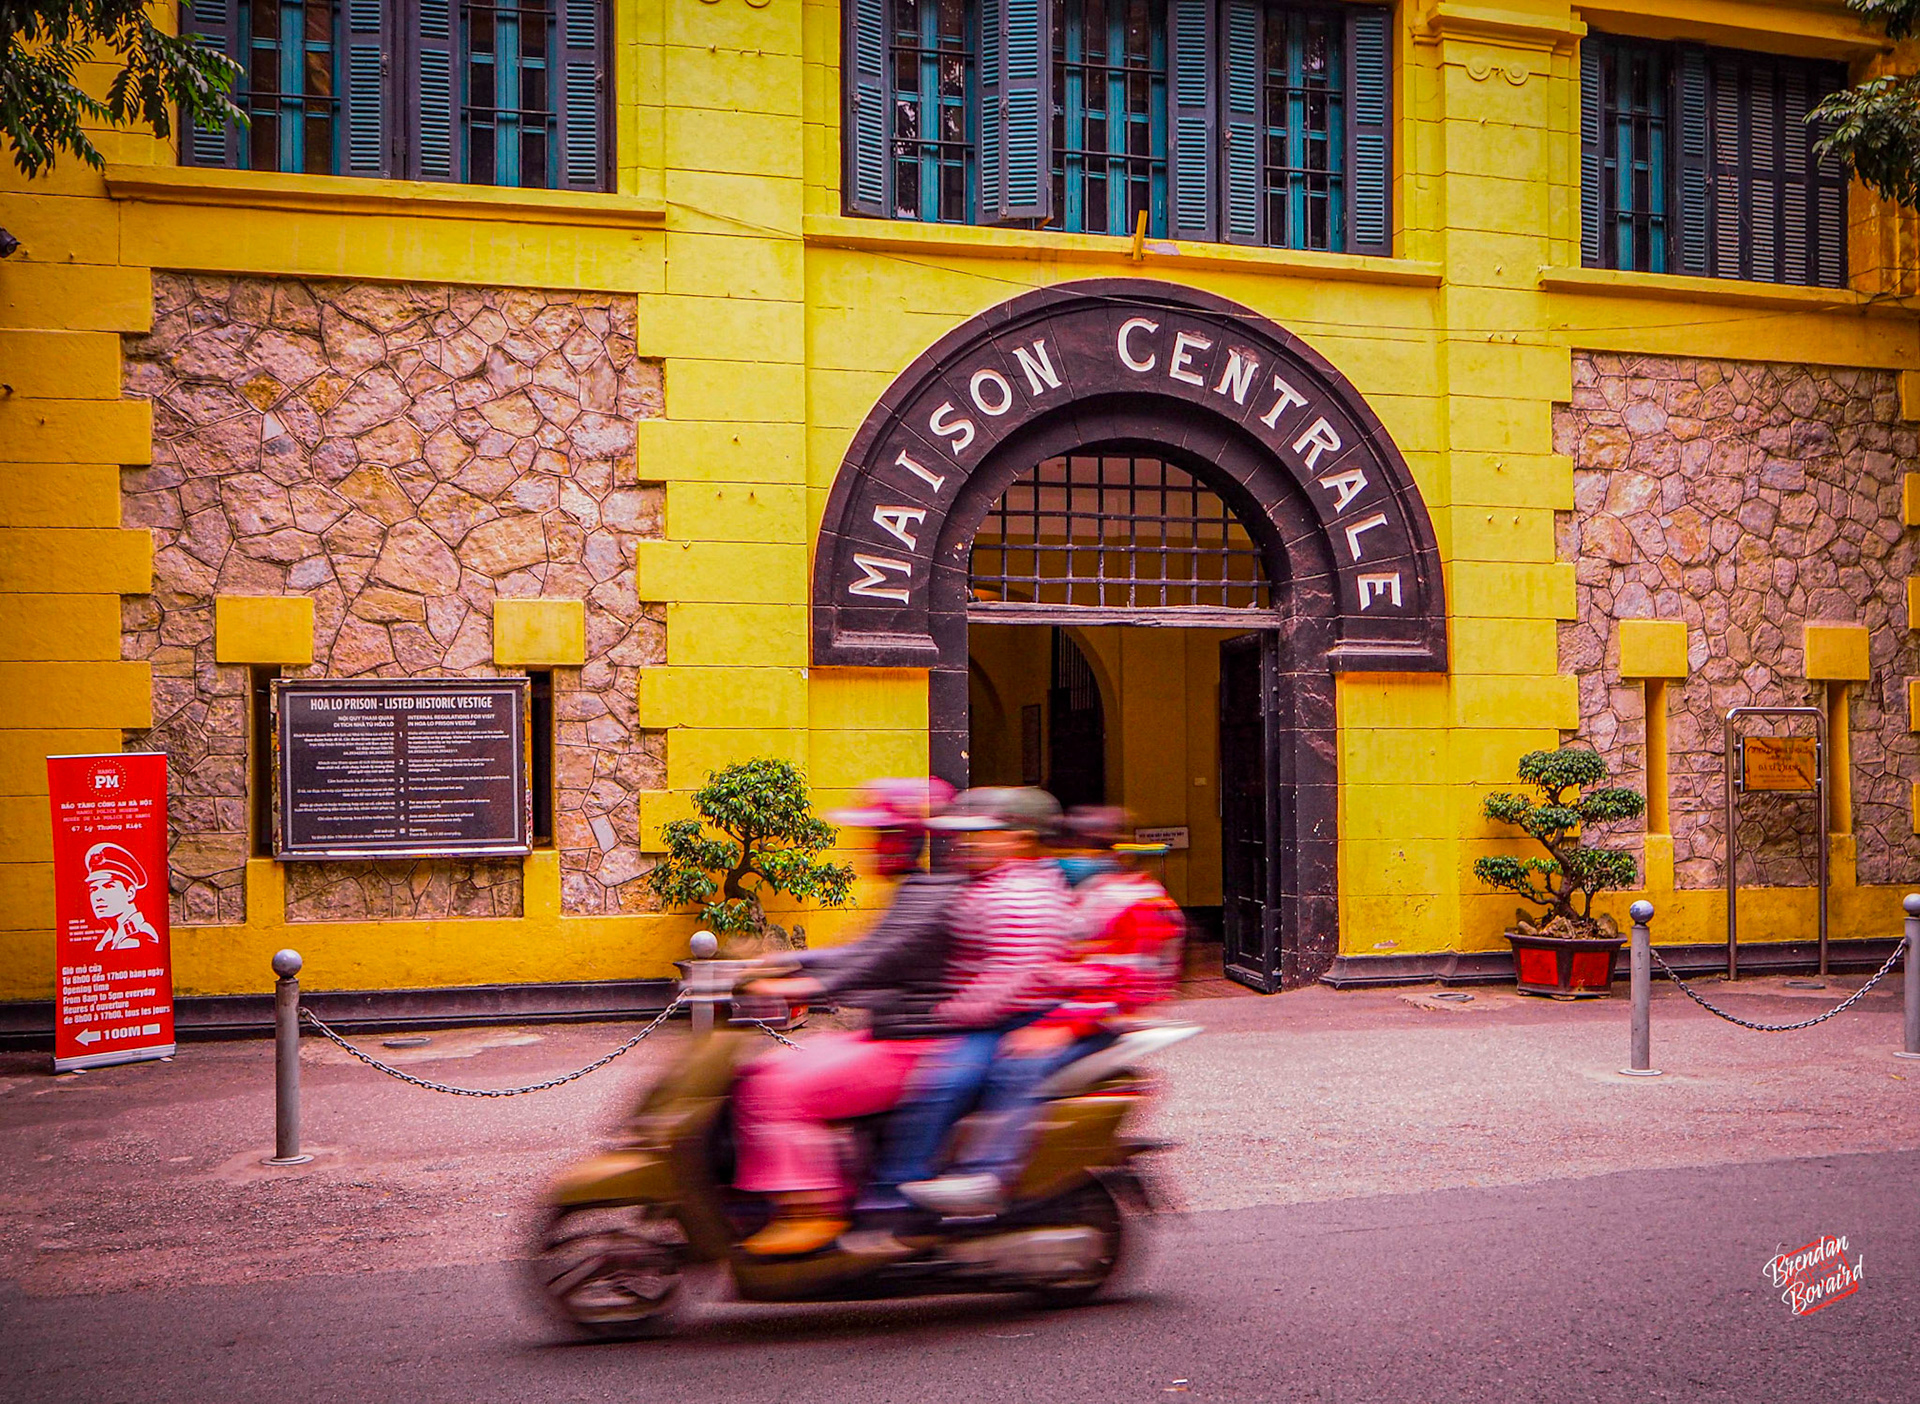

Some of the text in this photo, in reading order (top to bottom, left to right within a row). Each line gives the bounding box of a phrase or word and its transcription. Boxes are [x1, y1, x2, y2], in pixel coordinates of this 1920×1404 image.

[849, 317, 1402, 611] MAISON CENTRALE
[311, 699, 329, 710] HOA
[332, 698, 343, 710] LO
[345, 698, 377, 709] PRISON
[385, 698, 414, 709] LISTED
[416, 697, 456, 709] HISTORIC
[457, 697, 492, 708] VESTIGE
[95, 775, 119, 788] PM
[72, 974, 90, 984] 8h00
[107, 971, 128, 980] 17h00
[63, 983, 110, 995] Opening time
[63, 988, 156, 1005] From 8am to 5pm everyday
[63, 1004, 88, 1014] Heures
[64, 1015, 73, 1024] de
[74, 1013, 92, 1023] 8h00
[125, 1008, 140, 1018] tous
[141, 1007, 151, 1016] les
[153, 1005, 170, 1014] jours
[103, 1026, 140, 1040] 100M
